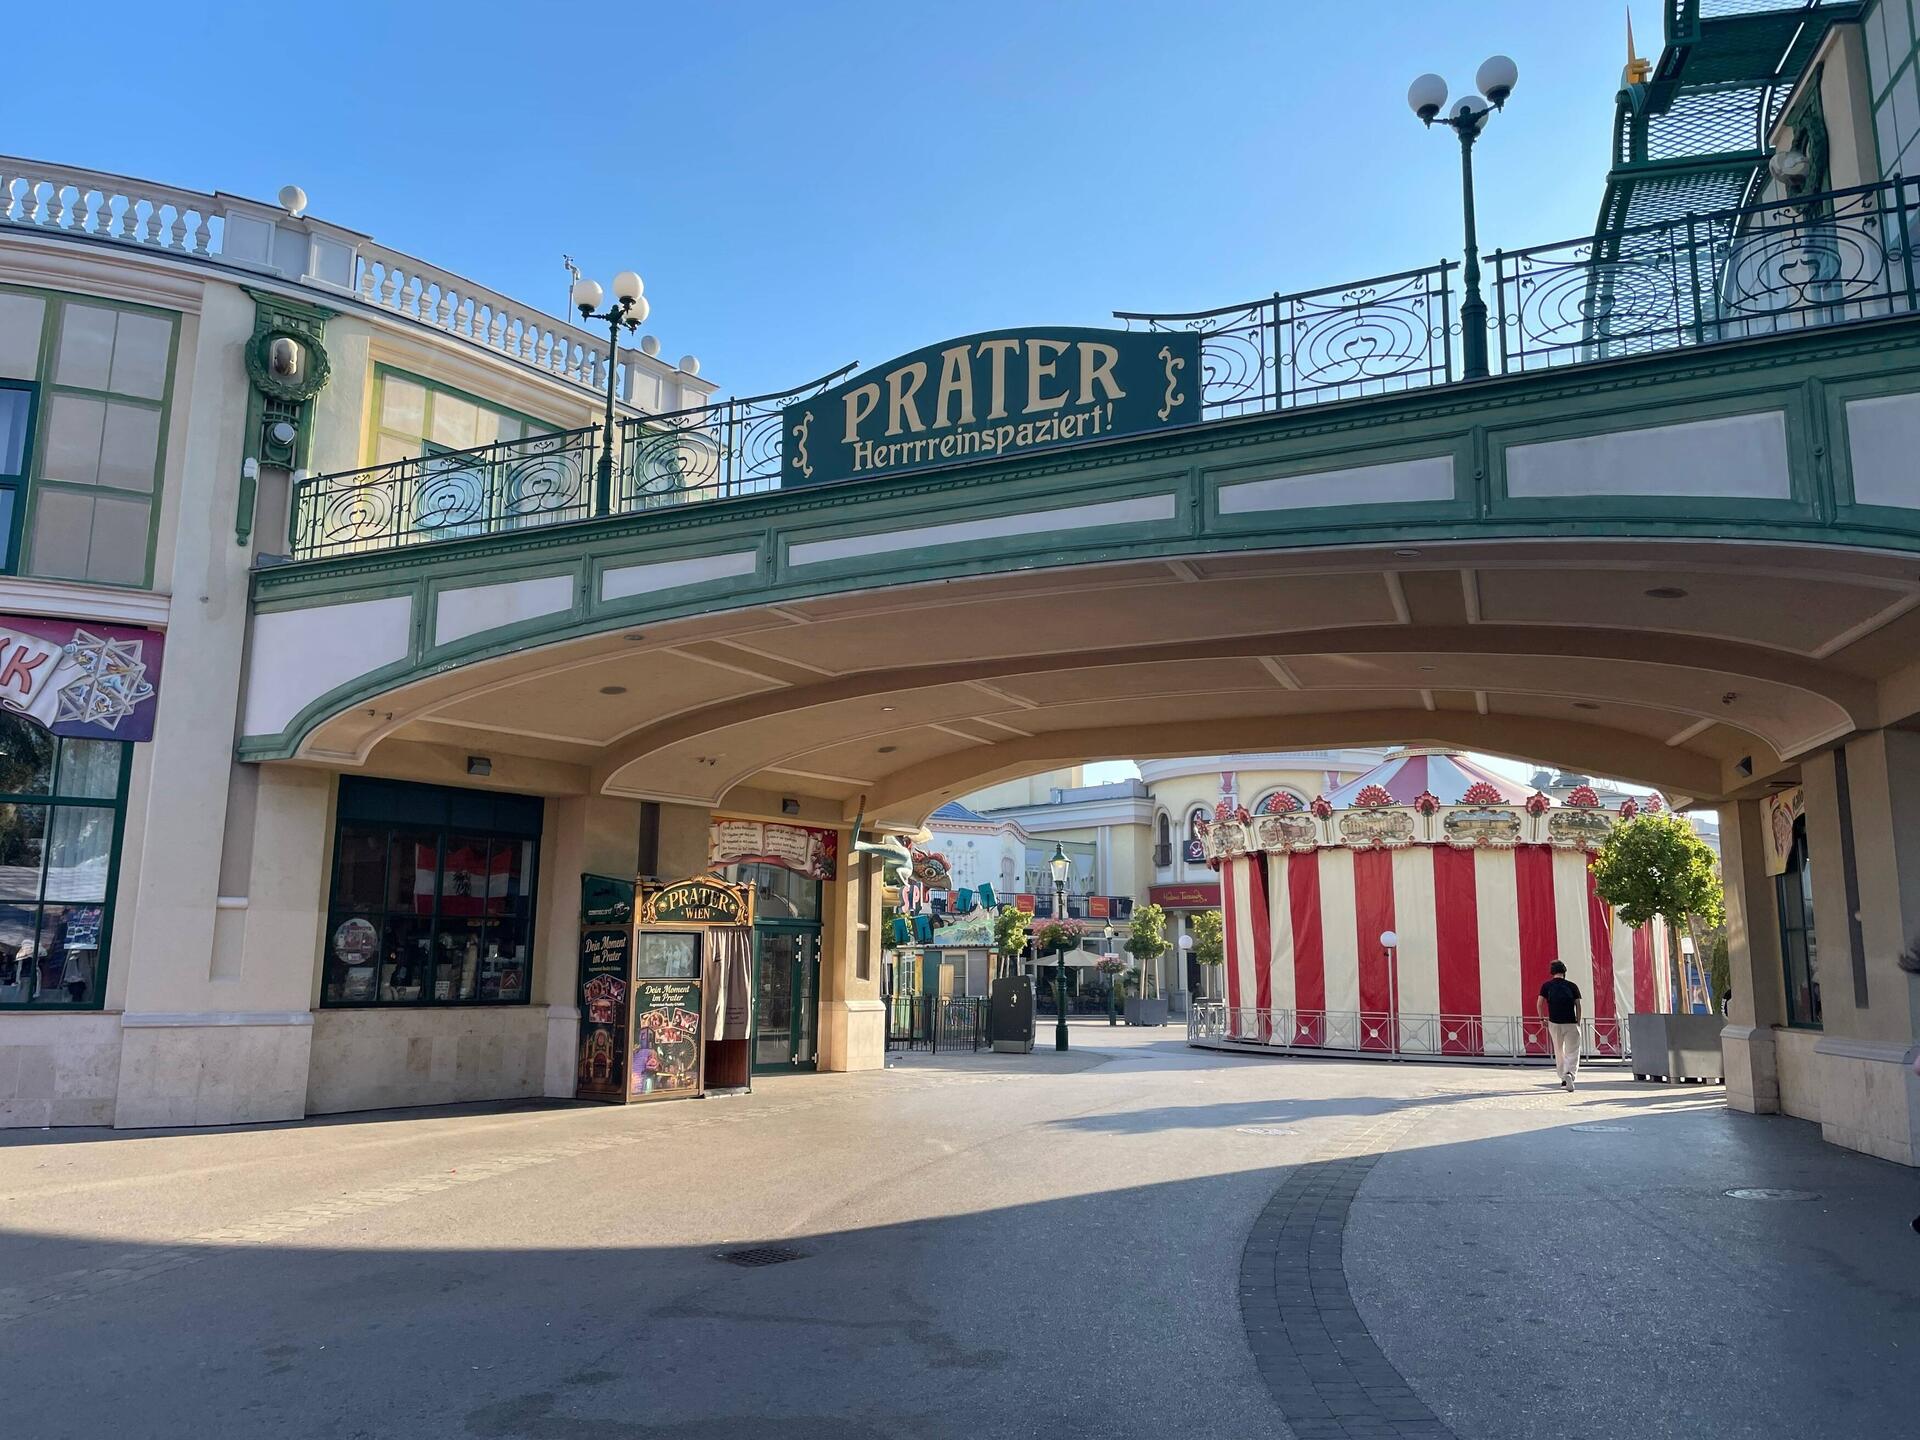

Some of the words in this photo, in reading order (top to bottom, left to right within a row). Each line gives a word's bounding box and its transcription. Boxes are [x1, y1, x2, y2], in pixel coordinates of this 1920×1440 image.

[841, 339, 1126, 443] PRATER
[852, 402, 1114, 471] Herrrreinspaziert!
[668, 887, 729, 913] PRATER
[685, 907, 711, 919] WIEN
[585, 938, 601, 953] Dein
[601, 936, 627, 950] Moment
[592, 953, 601, 964] im
[601, 949, 622, 963] Prater
[645, 985, 661, 995] Dein
[662, 984, 690, 994] Moment
[652, 994, 661, 1002] im
[662, 993, 683, 1002] Prater
